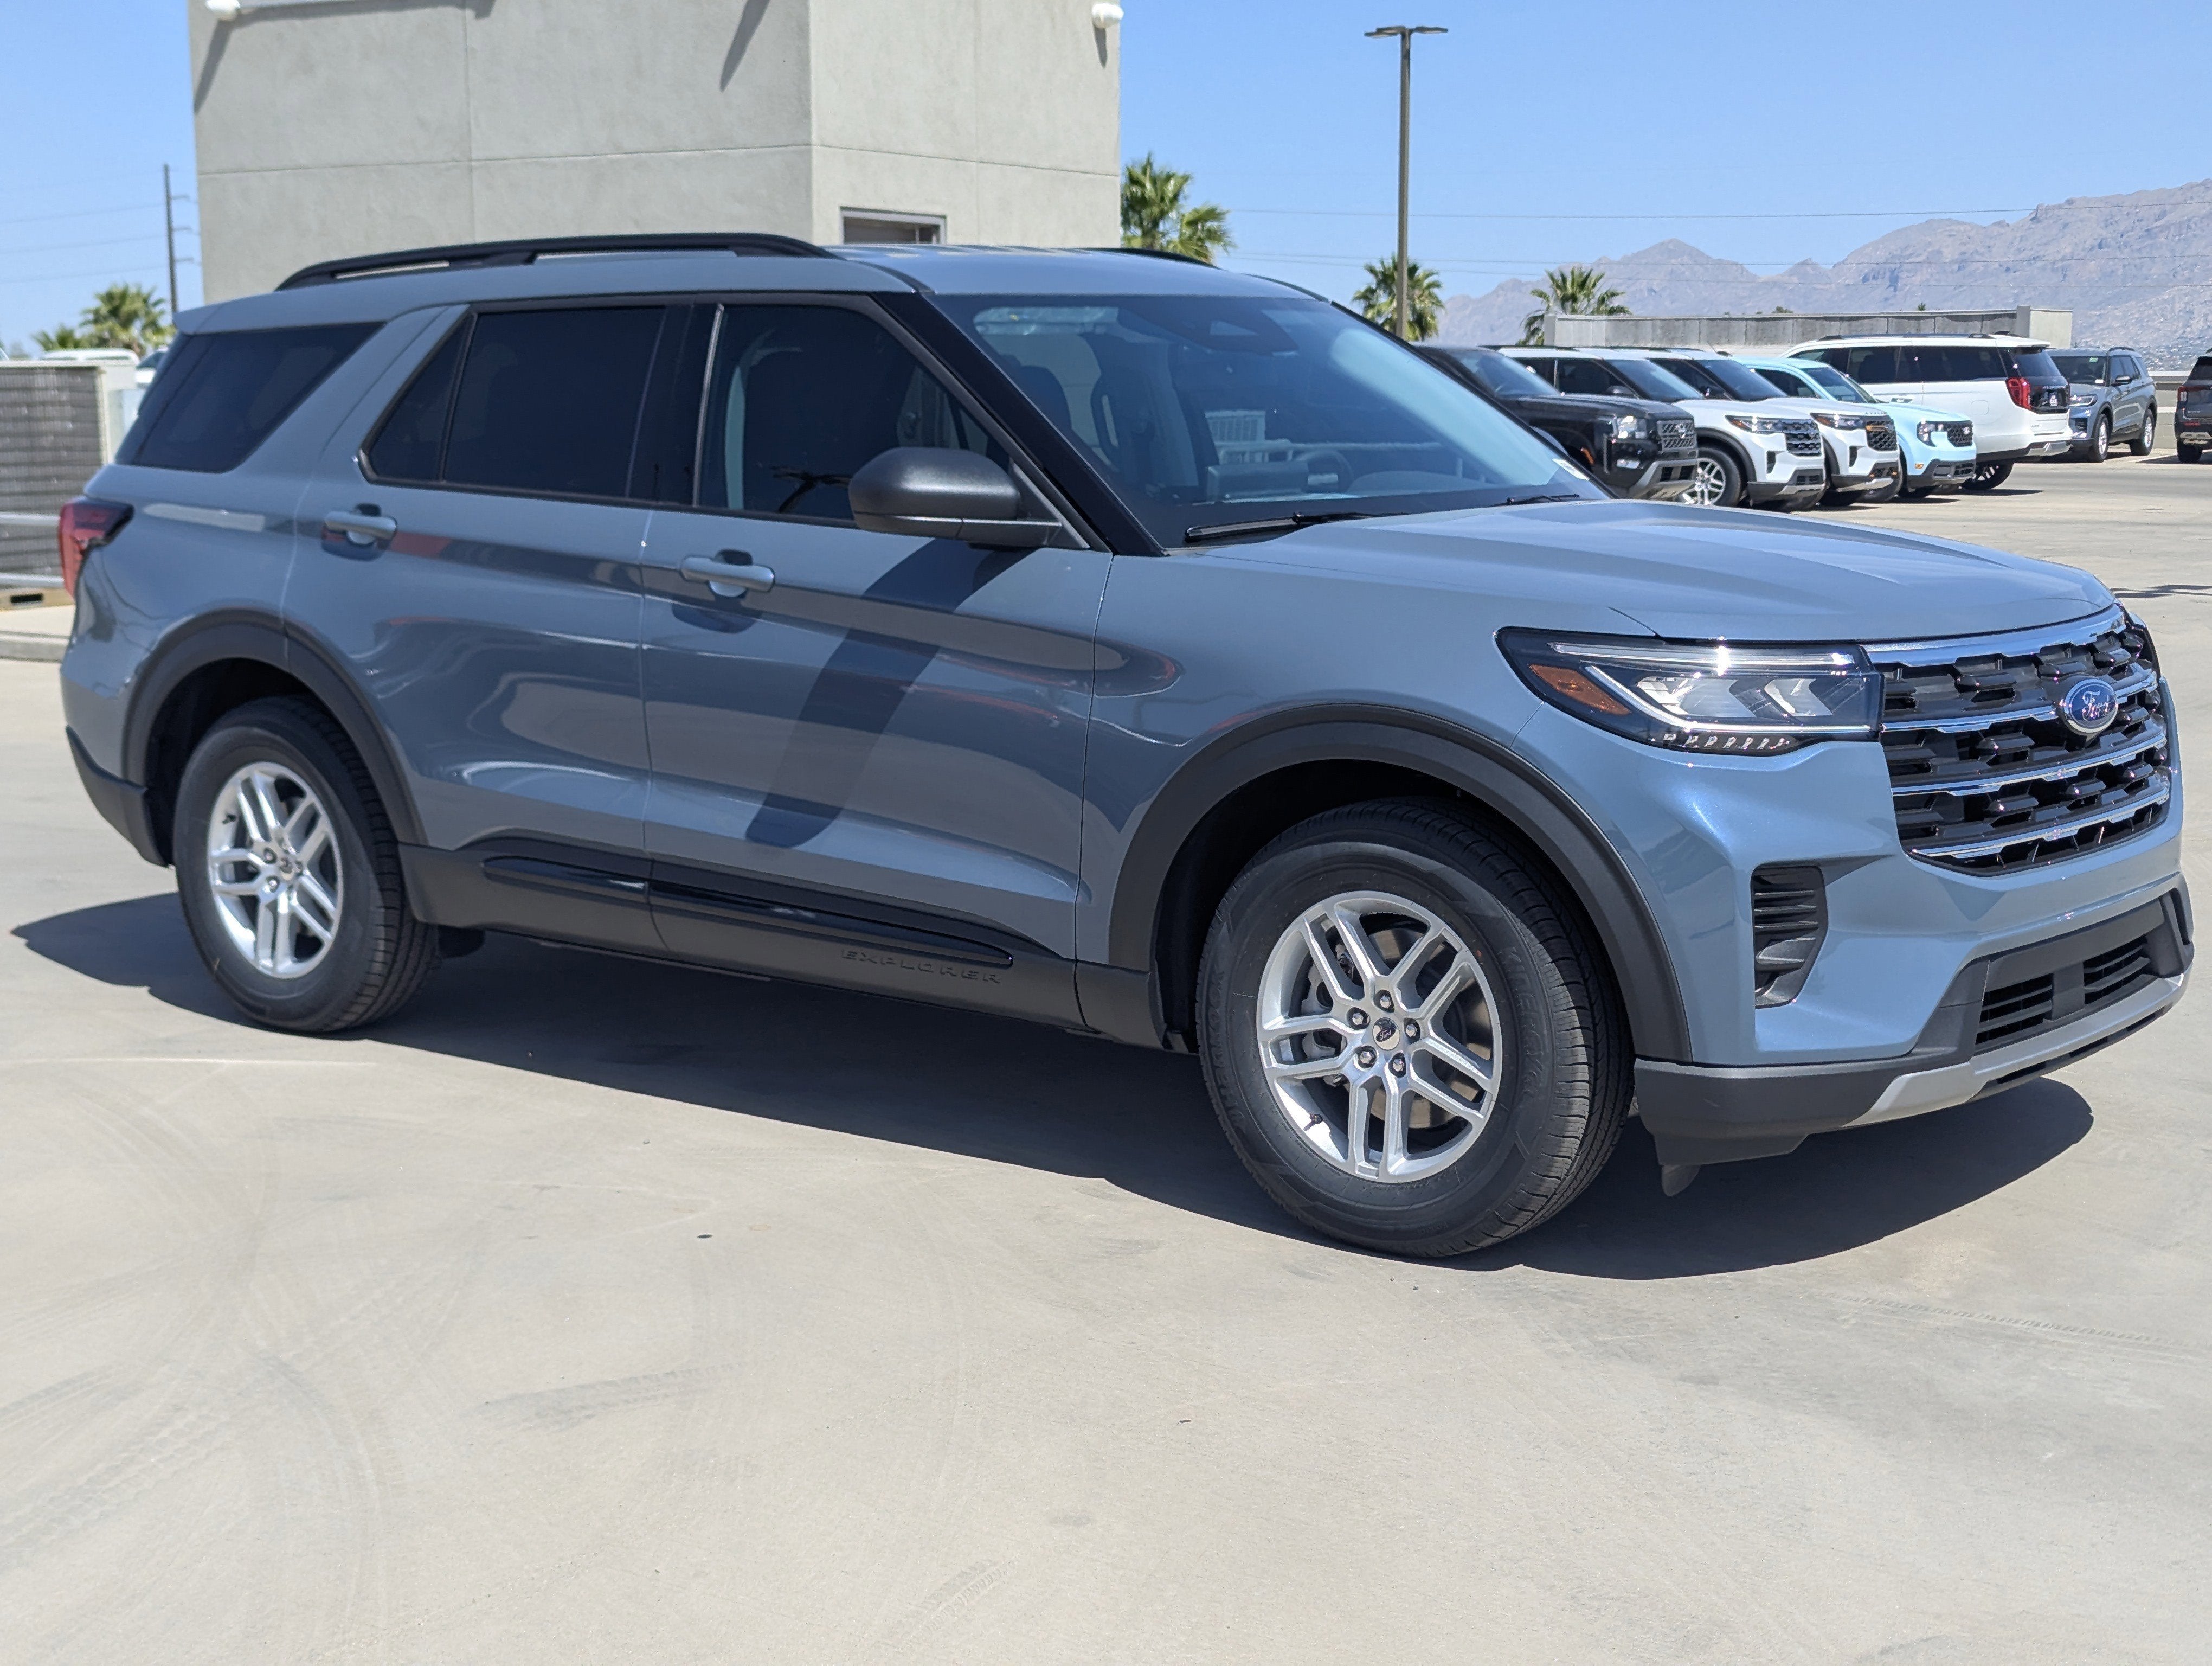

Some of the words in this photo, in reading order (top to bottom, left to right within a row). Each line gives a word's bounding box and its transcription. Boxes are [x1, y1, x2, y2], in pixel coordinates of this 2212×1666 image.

[2082, 690, 2111, 721] Ford
[840, 948, 1001, 984] EXPLORER
[1379, 1029, 1392, 1041] Ford
